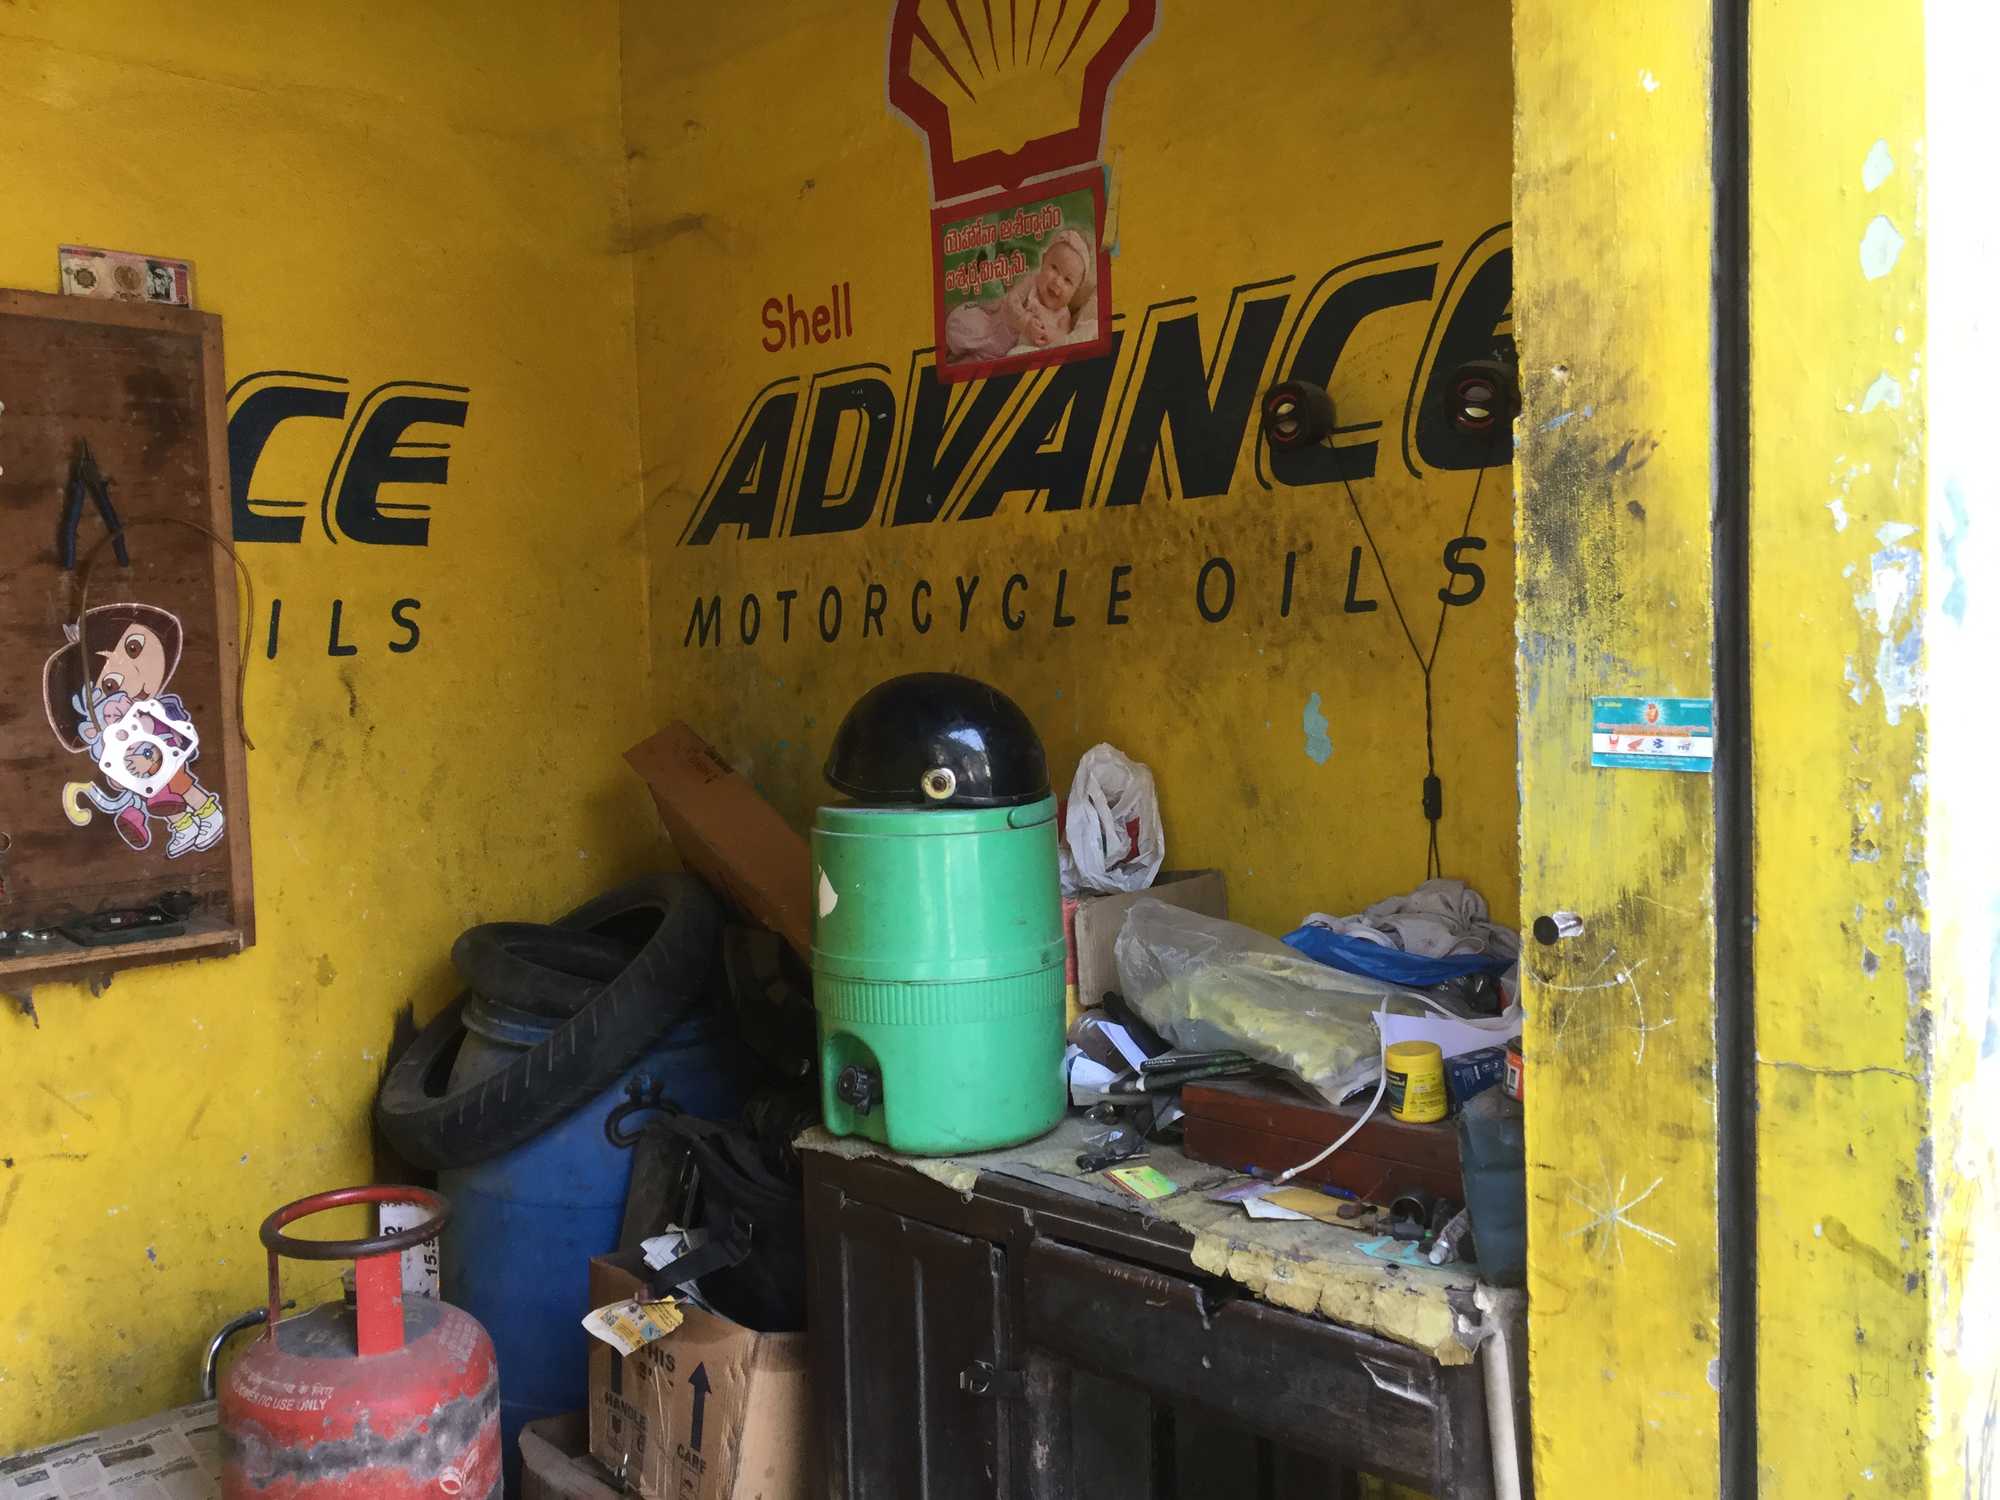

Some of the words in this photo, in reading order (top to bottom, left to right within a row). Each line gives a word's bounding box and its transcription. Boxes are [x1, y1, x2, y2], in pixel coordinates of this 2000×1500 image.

[762, 281, 853, 353] Shell
[684, 565, 1132, 648] MOTORCYCLE
[1196, 536, 1487, 624] OILS
[640, 1344, 676, 1372] HIS
[272, 1397, 295, 1411] USE
[604, 1391, 648, 1427] HANDLE
[676, 1442, 707, 1474] CARE
